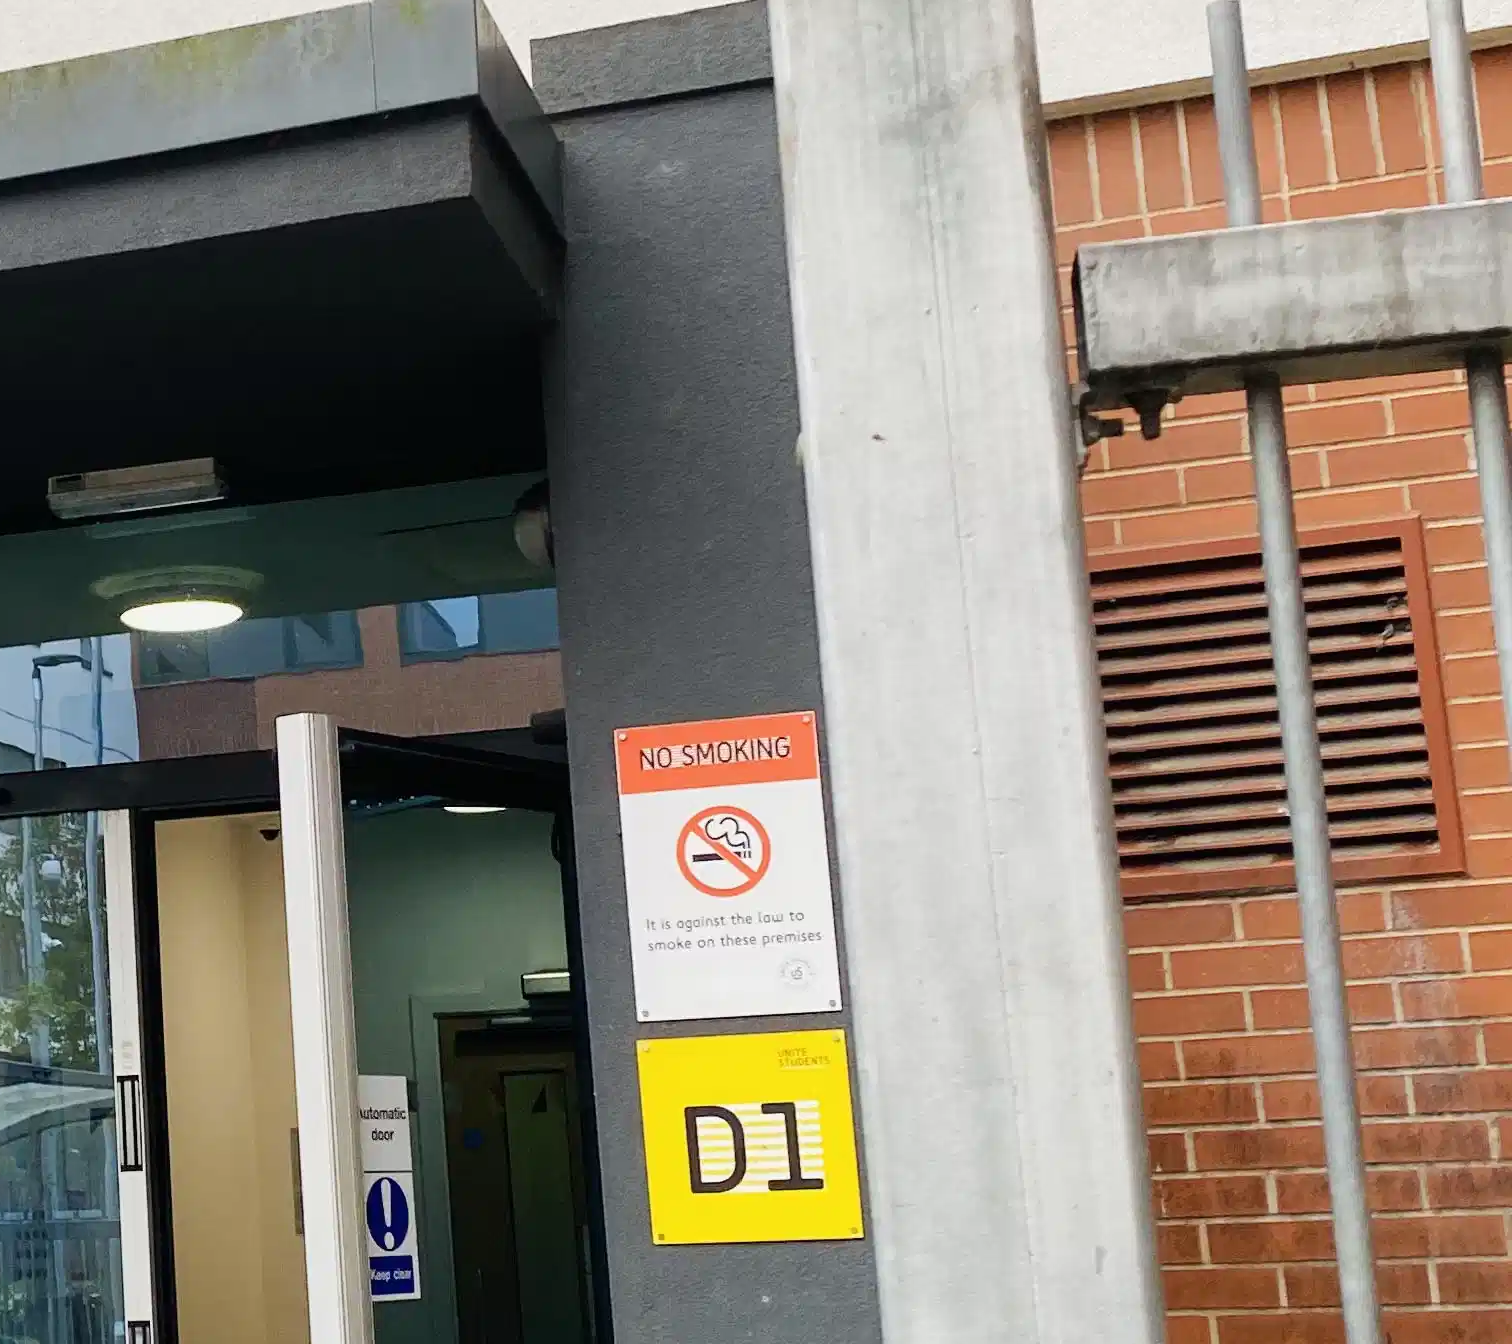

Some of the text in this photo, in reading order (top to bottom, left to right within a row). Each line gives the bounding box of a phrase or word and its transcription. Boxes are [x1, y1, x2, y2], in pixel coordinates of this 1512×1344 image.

[638, 736, 791, 771] NO SMOKING
[646, 911, 805, 932] It is against the law to
[648, 930, 823, 952] smoke on these premises
[777, 1047, 808, 1058] UNITE
[778, 1055, 831, 1068] STUDENTS
[371, 1129, 395, 1142] door
[683, 1101, 825, 1195] D1
[393, 1268, 412, 1280] clear
